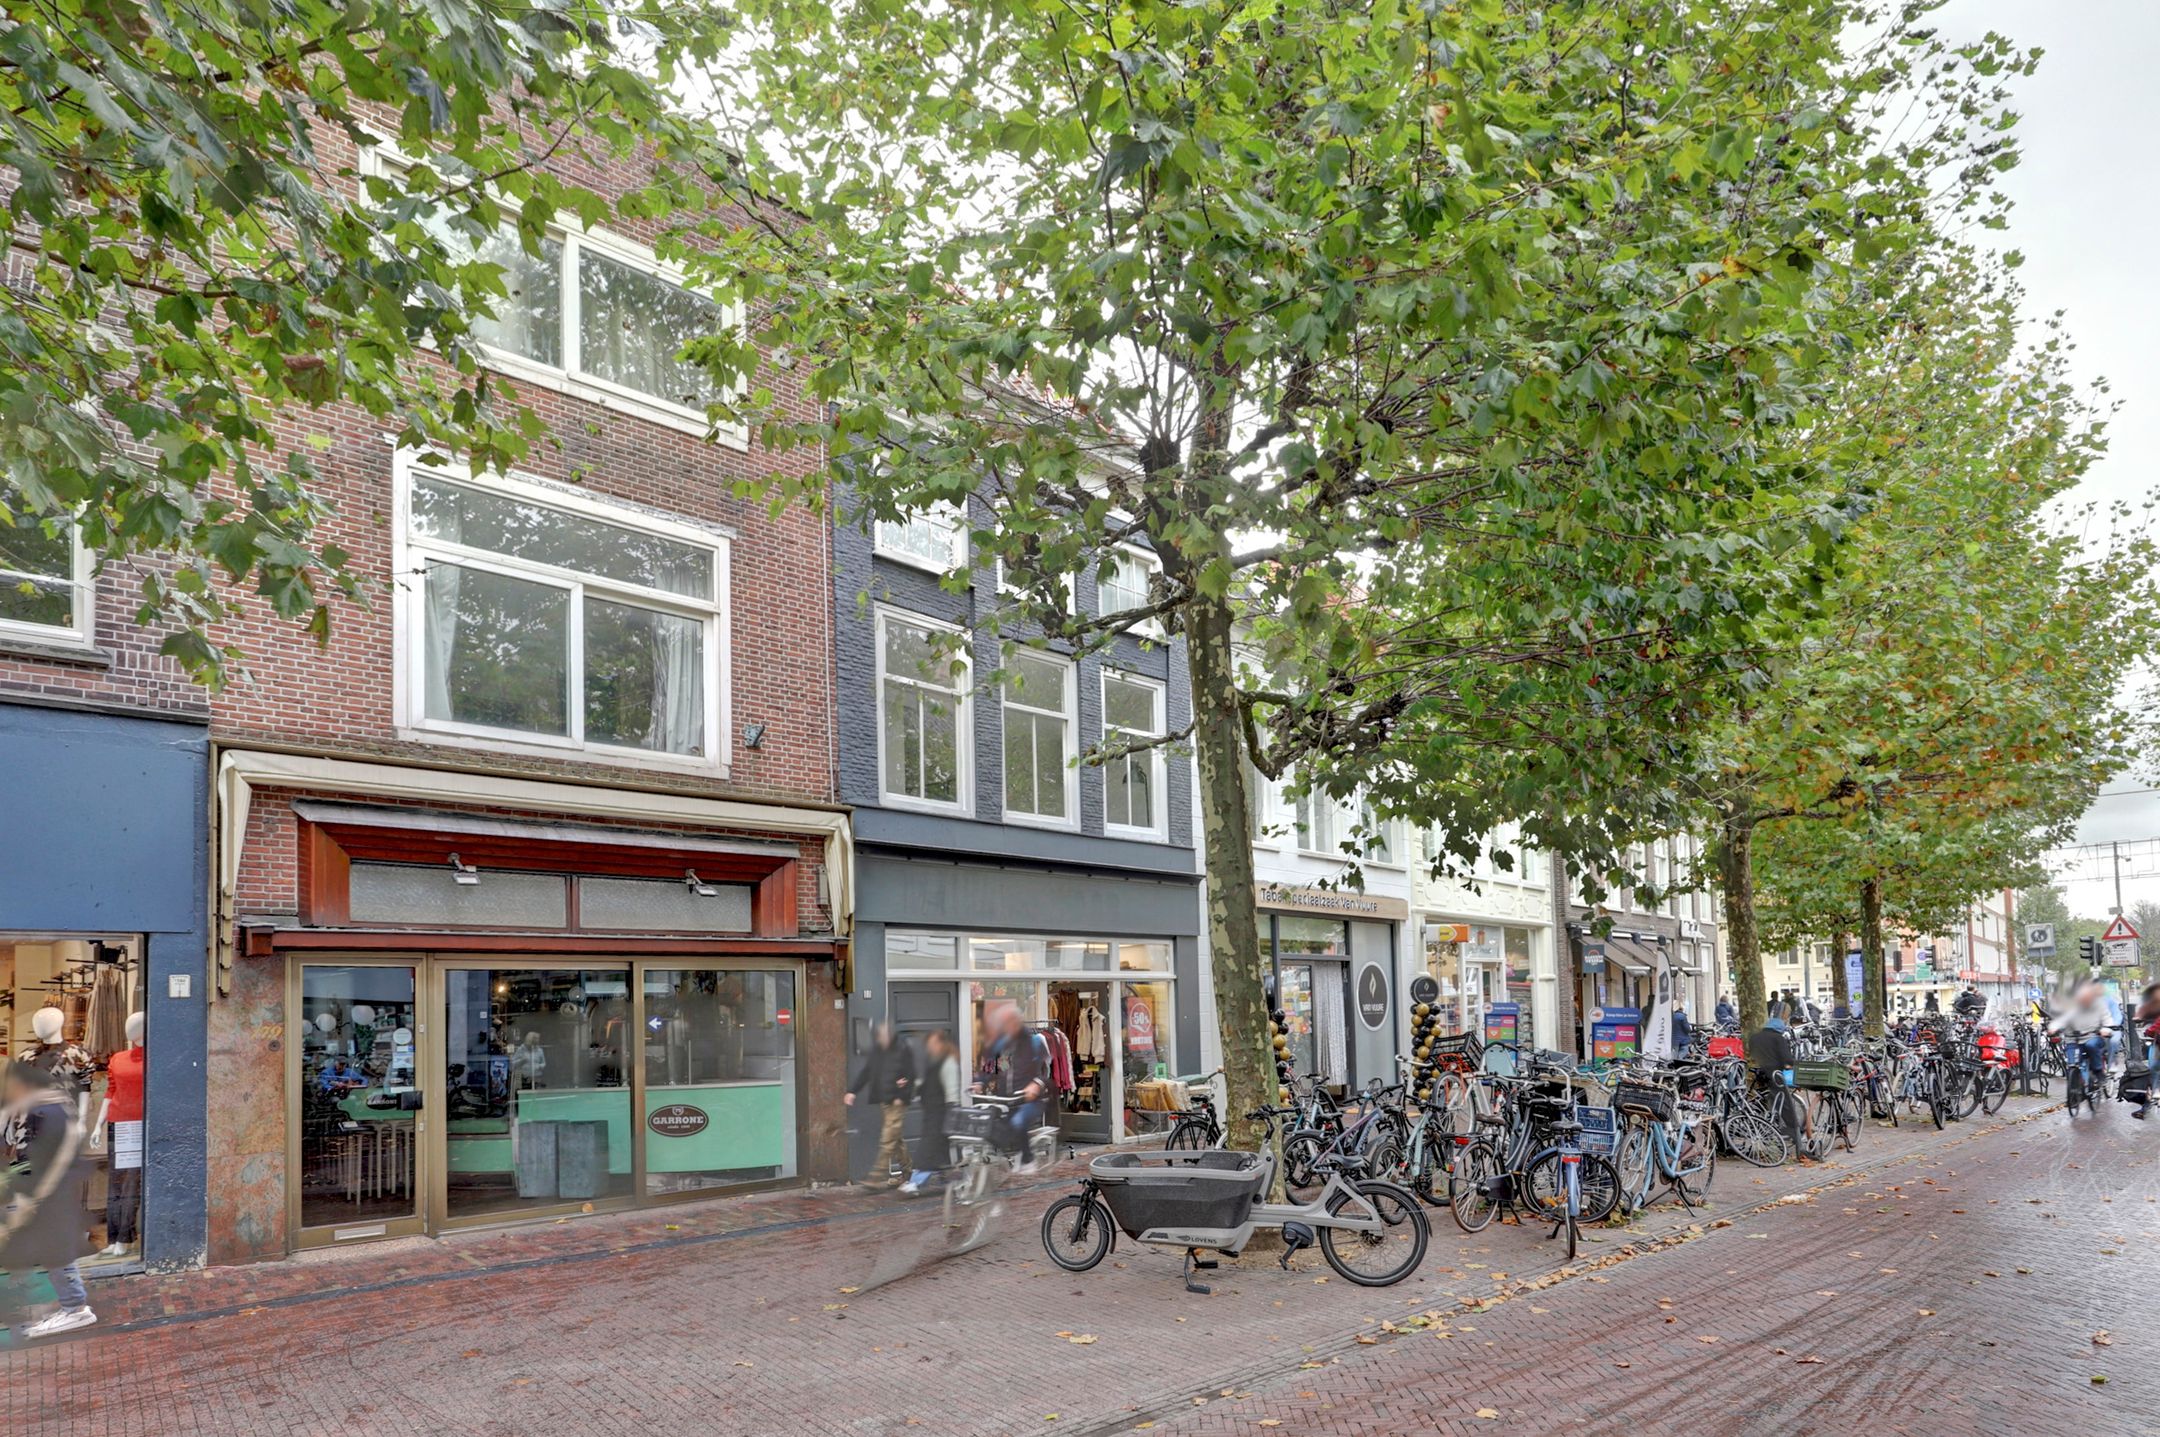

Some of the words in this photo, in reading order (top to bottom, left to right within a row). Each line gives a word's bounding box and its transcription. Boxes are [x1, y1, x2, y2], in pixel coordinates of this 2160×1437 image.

[1260, 888, 1339, 908] Tabapeciaalzaak
[1340, 896, 1355, 910] Van
[652, 1116, 704, 1125] GARRONE
